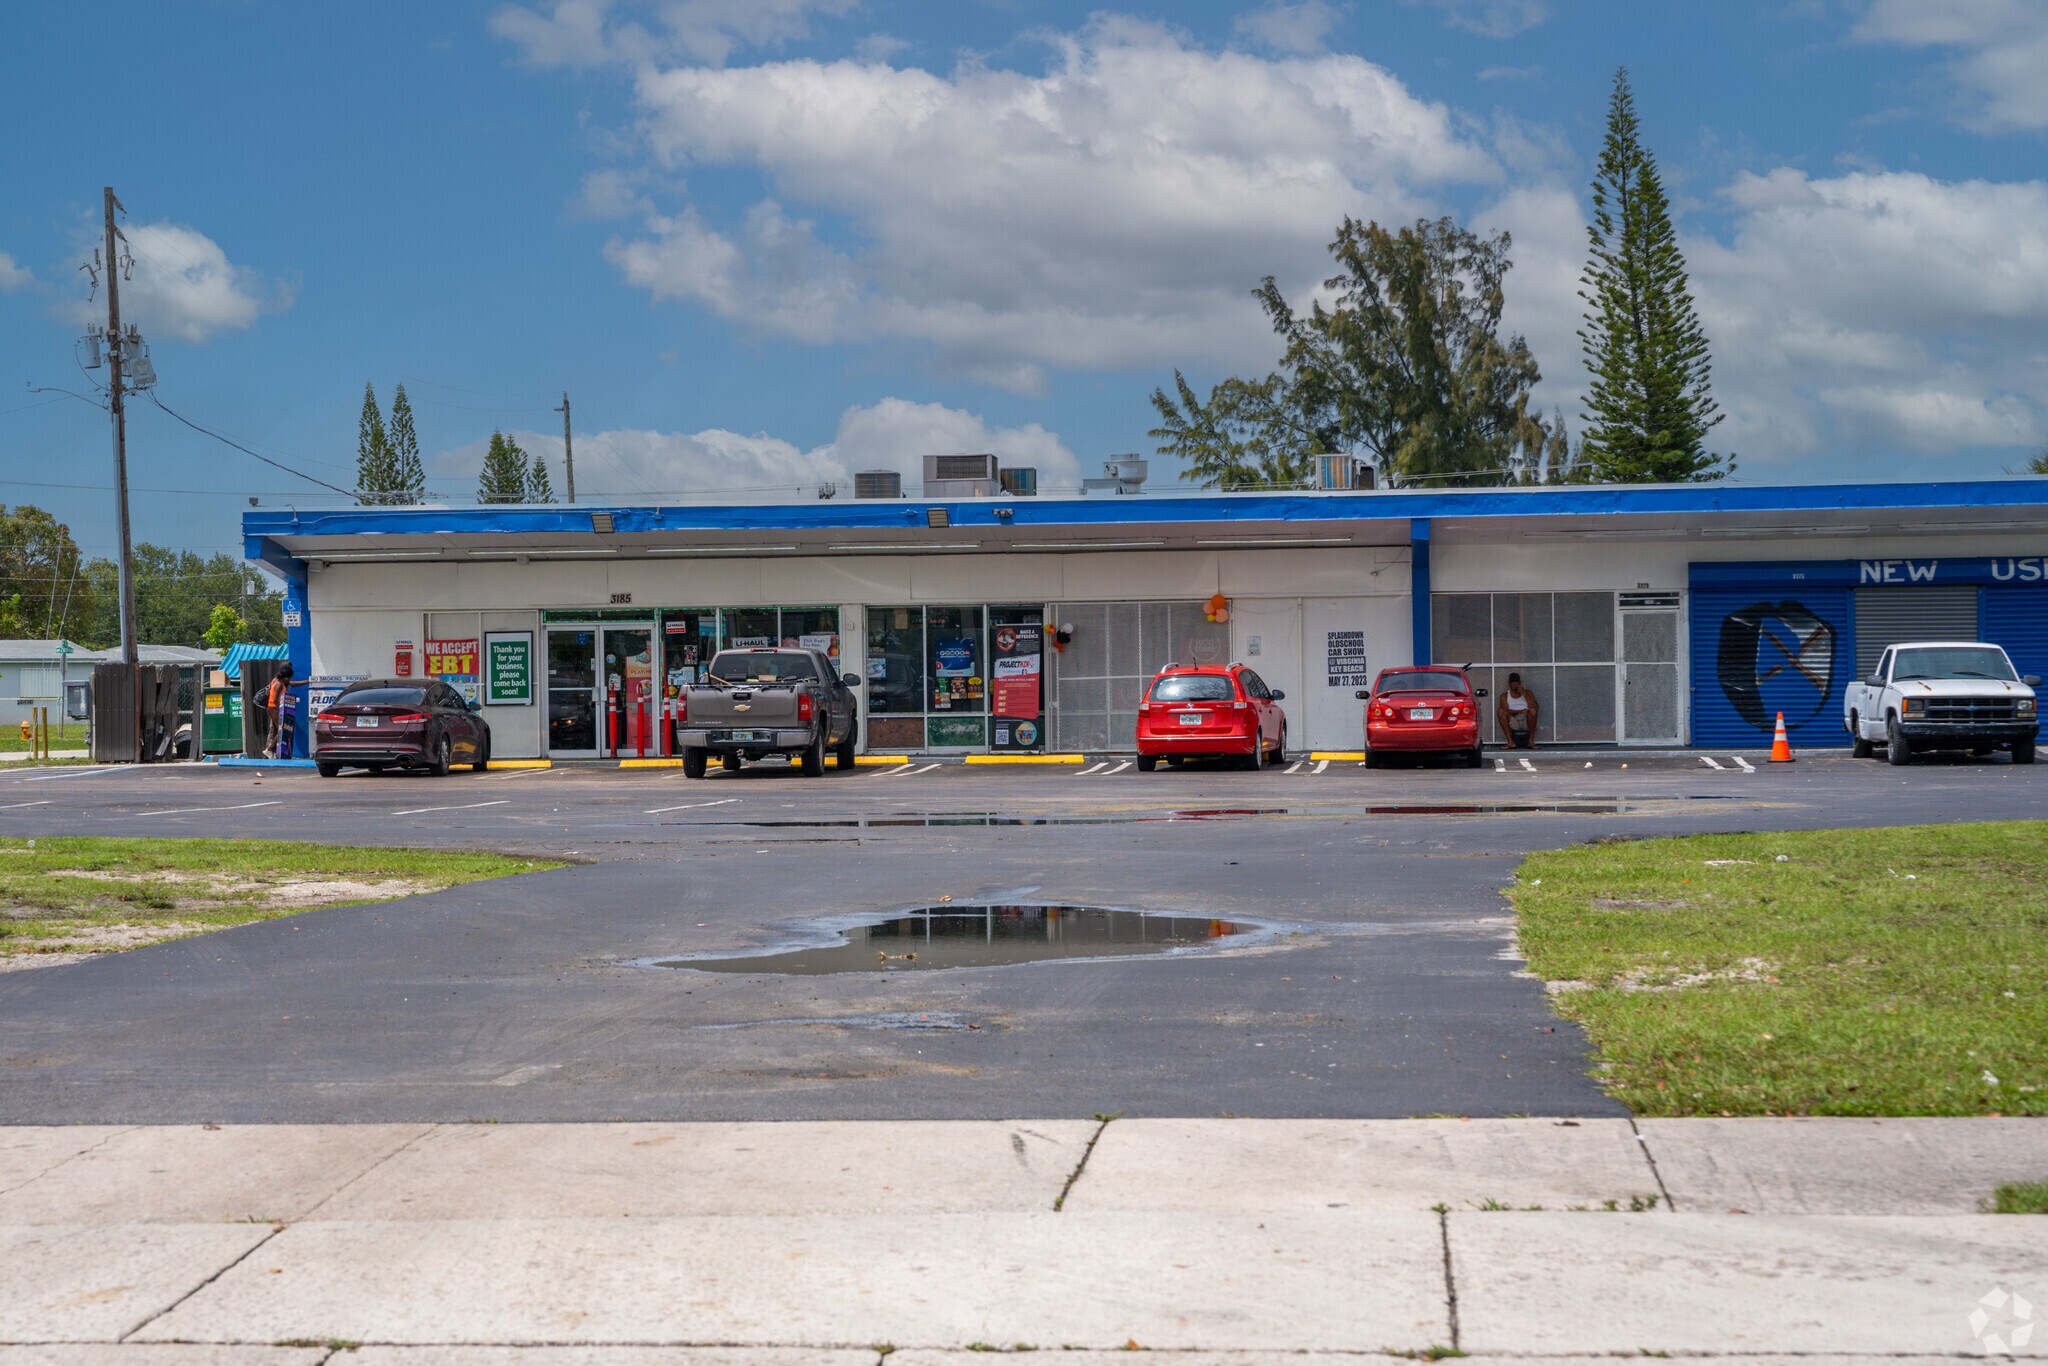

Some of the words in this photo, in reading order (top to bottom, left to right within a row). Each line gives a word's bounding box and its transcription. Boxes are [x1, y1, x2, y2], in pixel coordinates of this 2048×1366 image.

[1860, 560, 1938, 583] NEW
[1991, 558, 2048, 582] US
[610, 593, 631, 604] 3185
[1328, 631, 1364, 640] SPLASHDOWN
[426, 643, 440, 654] WE
[442, 641, 478, 654] ACCEPT
[1328, 639, 1364, 648] OLDSCHOOL
[493, 645, 513, 653] Thank
[1328, 648, 1342, 656] CAR
[1343, 648, 1364, 656] SHOW
[429, 655, 473, 674] EBT
[1336, 657, 1364, 665] VIRGINIA
[1330, 665, 1342, 673] KEY
[1343, 664, 1363, 672] BEACH
[499, 671, 520, 680] please
[1328, 676, 1341, 687] MAY
[1351, 675, 1367, 686] 2023
